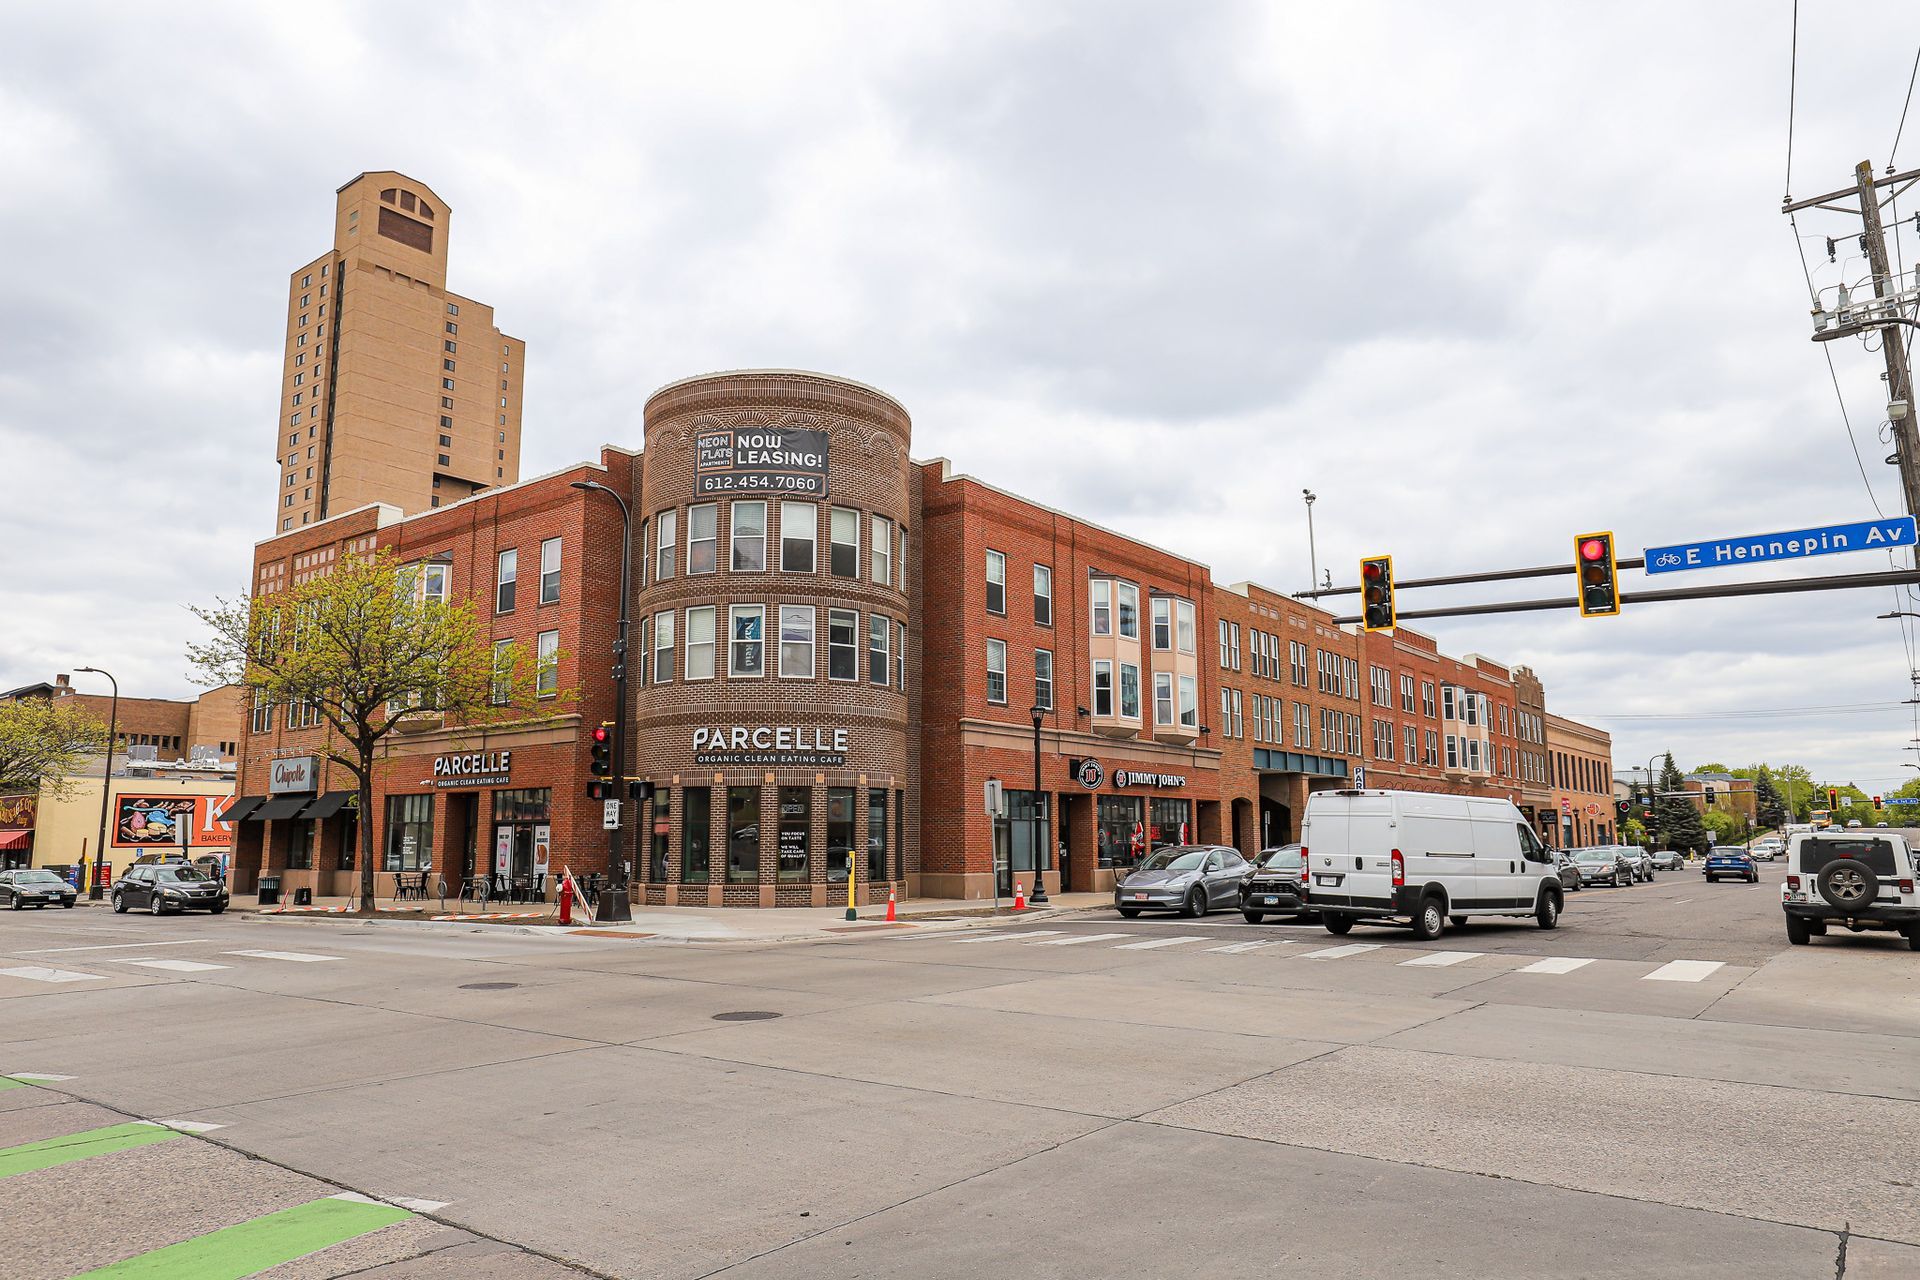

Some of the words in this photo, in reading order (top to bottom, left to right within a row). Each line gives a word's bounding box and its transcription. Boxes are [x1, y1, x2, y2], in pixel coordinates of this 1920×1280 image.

[698, 436, 728, 448] NEON
[737, 435, 781, 449] NOW
[701, 447, 733, 460] FLATS
[737, 451, 822, 468] LEASING!
[700, 459, 730, 467] APARTMENTS
[705, 476, 816, 490] 612.454.7060
[1686, 549, 1701, 565] E
[1715, 532, 1848, 561] Hennepin
[1865, 526, 1902, 544] Av
[693, 727, 848, 751] PARCELLE
[433, 751, 510, 776] PARCELLE
[698, 755, 740, 763] ORGANIC
[781, 755, 816, 763] EATING
[275, 763, 305, 788] Chipotle
[1085, 769, 1097, 783] JJ
[1127, 772, 1158, 786] JIMMY
[1158, 774, 1186, 788] JOHN'S
[782, 804, 803, 813] OPEN
